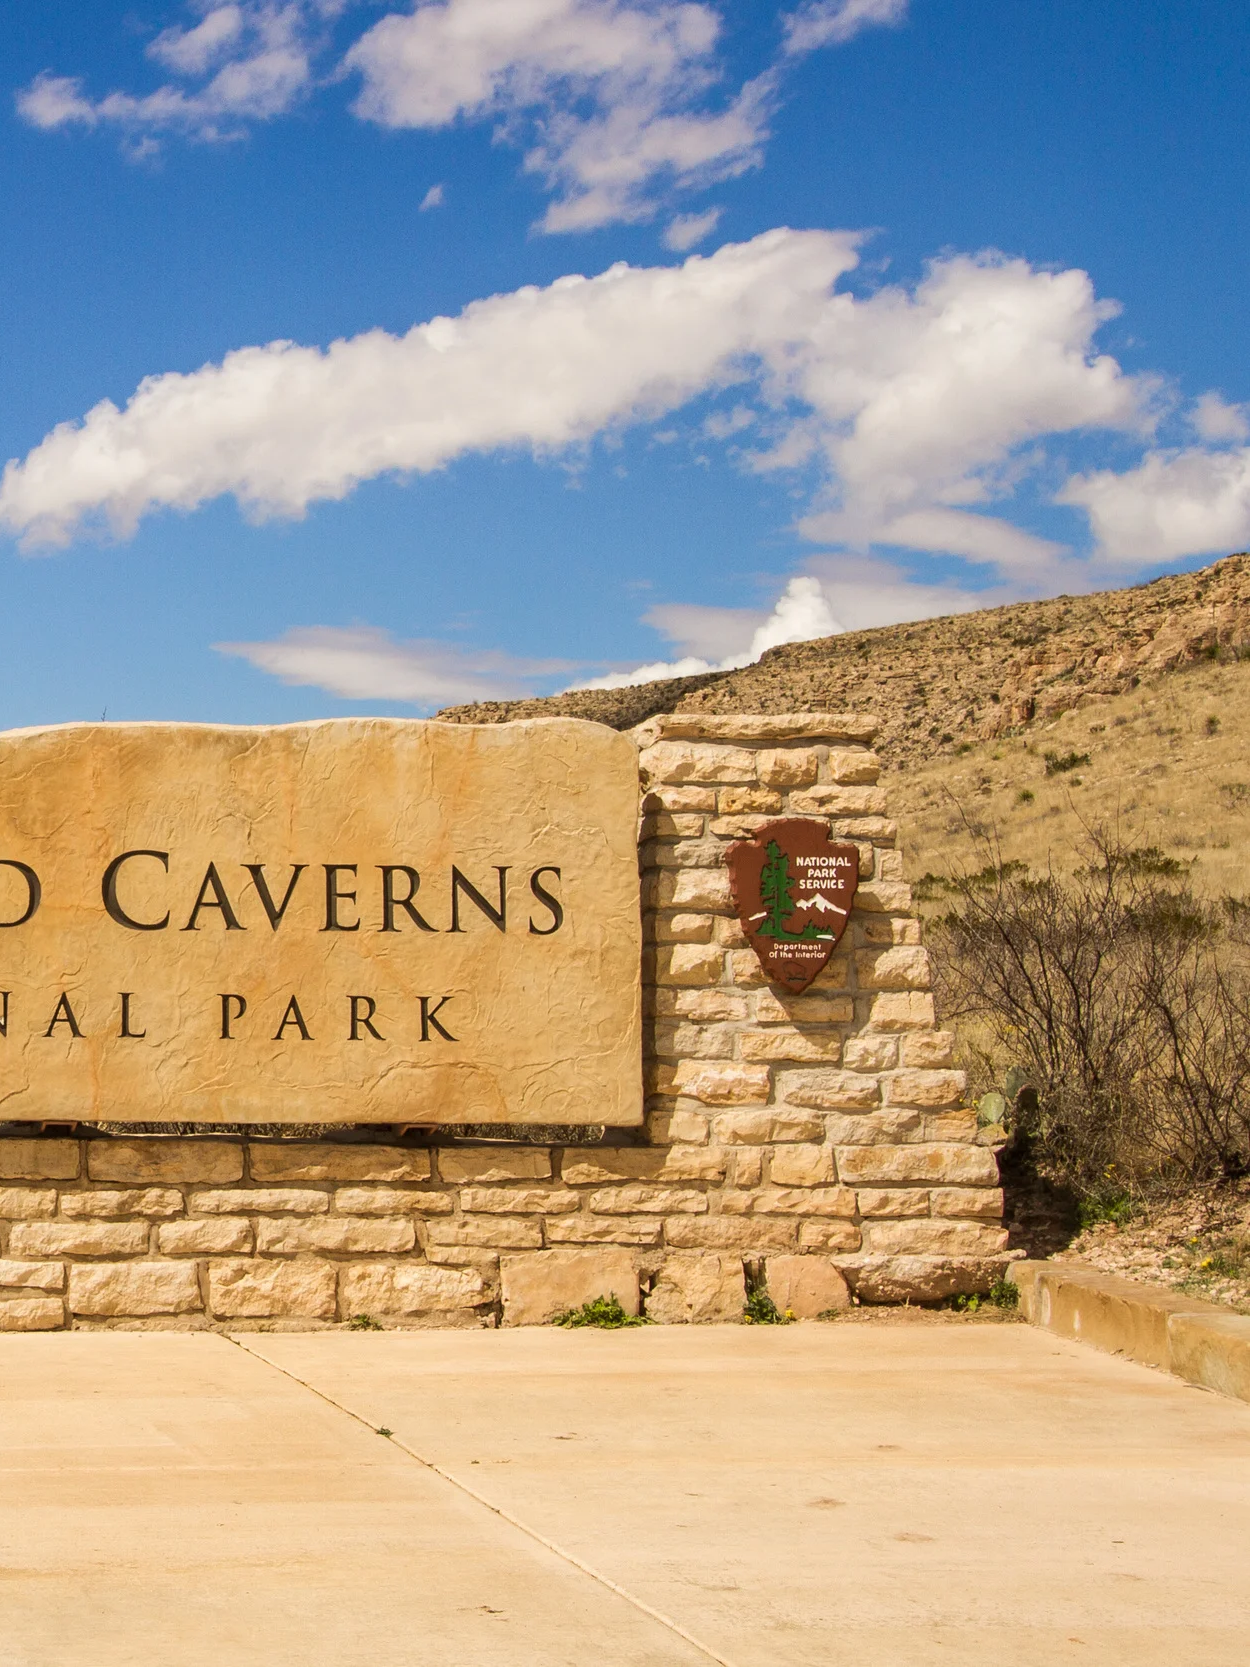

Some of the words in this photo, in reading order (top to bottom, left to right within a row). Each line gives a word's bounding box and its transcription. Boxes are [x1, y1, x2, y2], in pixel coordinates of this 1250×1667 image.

[796, 856, 851, 866] NATIONAL
[807, 868, 837, 878] PARK
[799, 879, 845, 889] SERVICE
[101, 849, 565, 936] CAVERNS
[773, 943, 822, 951] Department
[216, 992, 461, 1043] PARK
